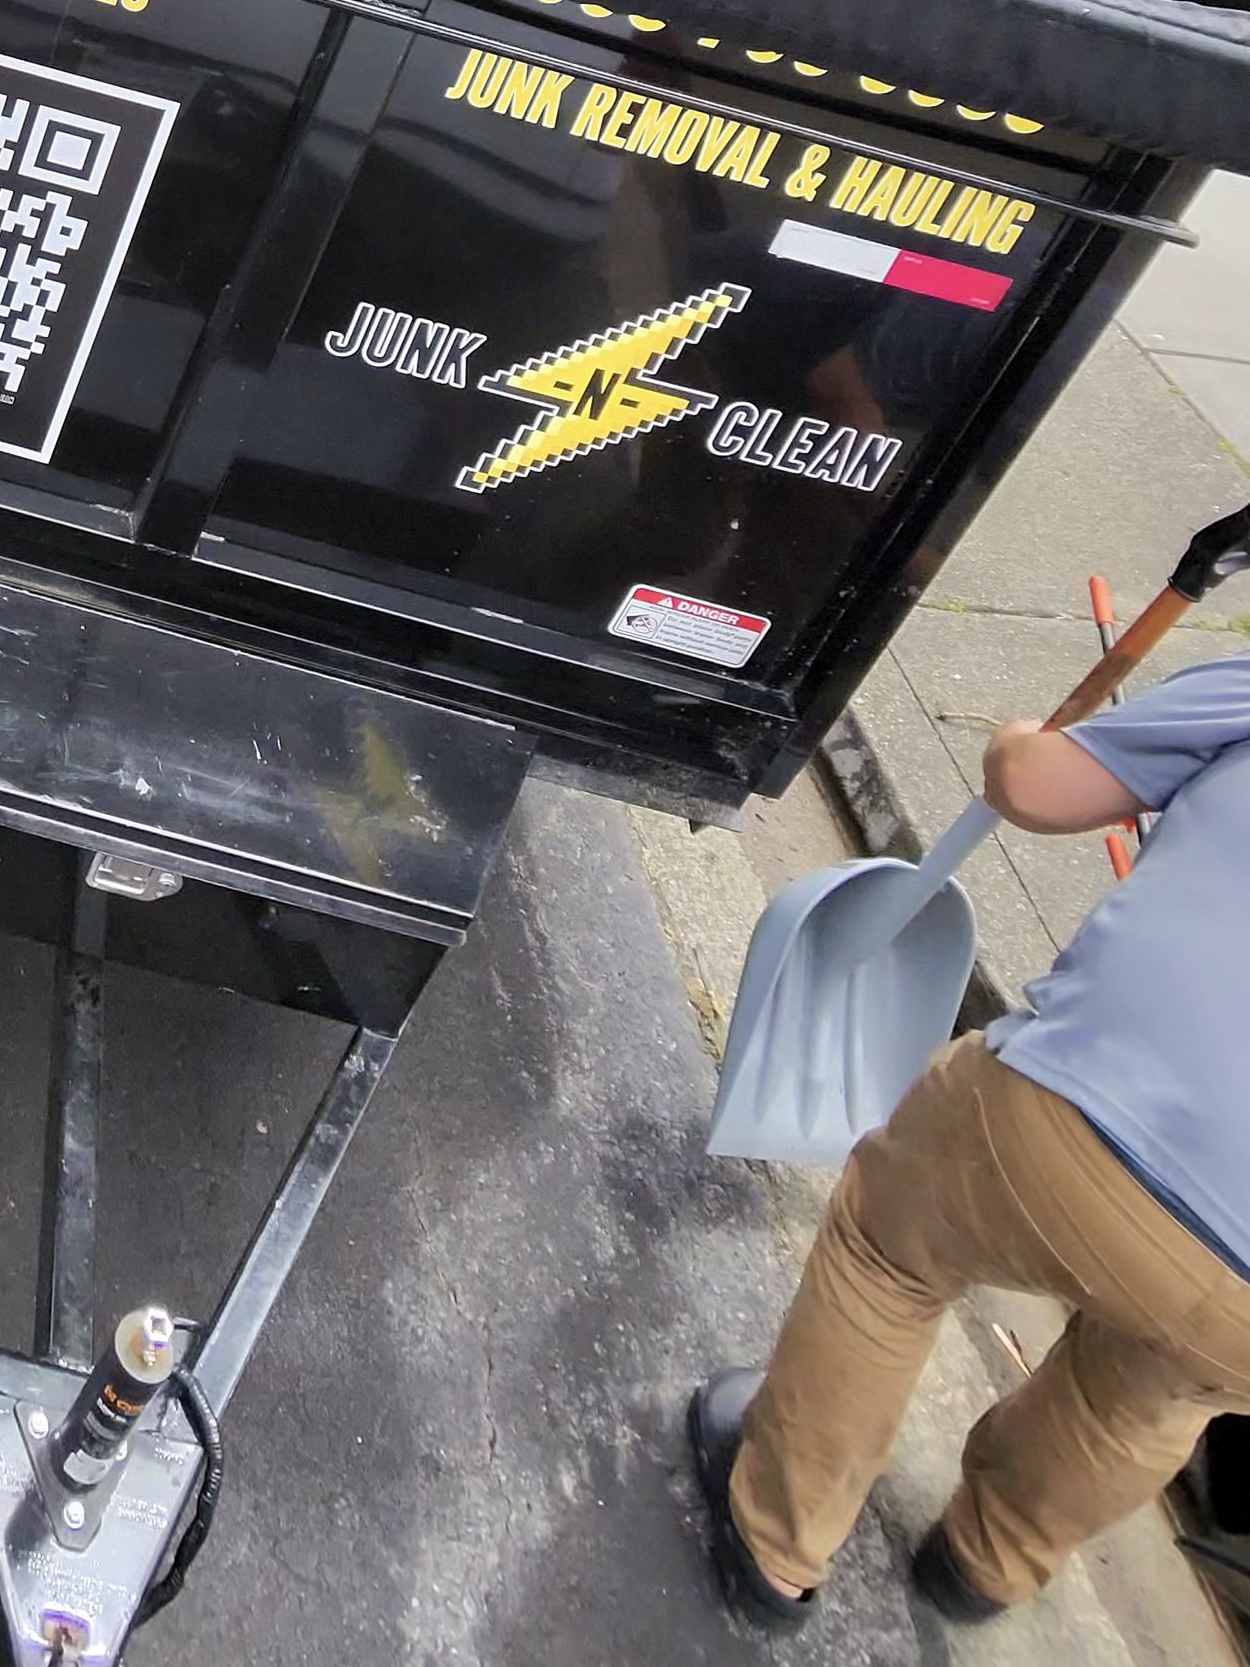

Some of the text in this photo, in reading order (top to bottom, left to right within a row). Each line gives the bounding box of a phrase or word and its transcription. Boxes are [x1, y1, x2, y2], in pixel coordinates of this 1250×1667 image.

[445, 46, 576, 130] JUNK
[570, 81, 782, 190] REMOVAL
[784, 142, 833, 201] &
[830, 154, 1038, 255] HAULING
[324, 301, 489, 390] JUNK
[706, 401, 903, 492] CLEAN
[677, 601, 740, 625] DANGER
